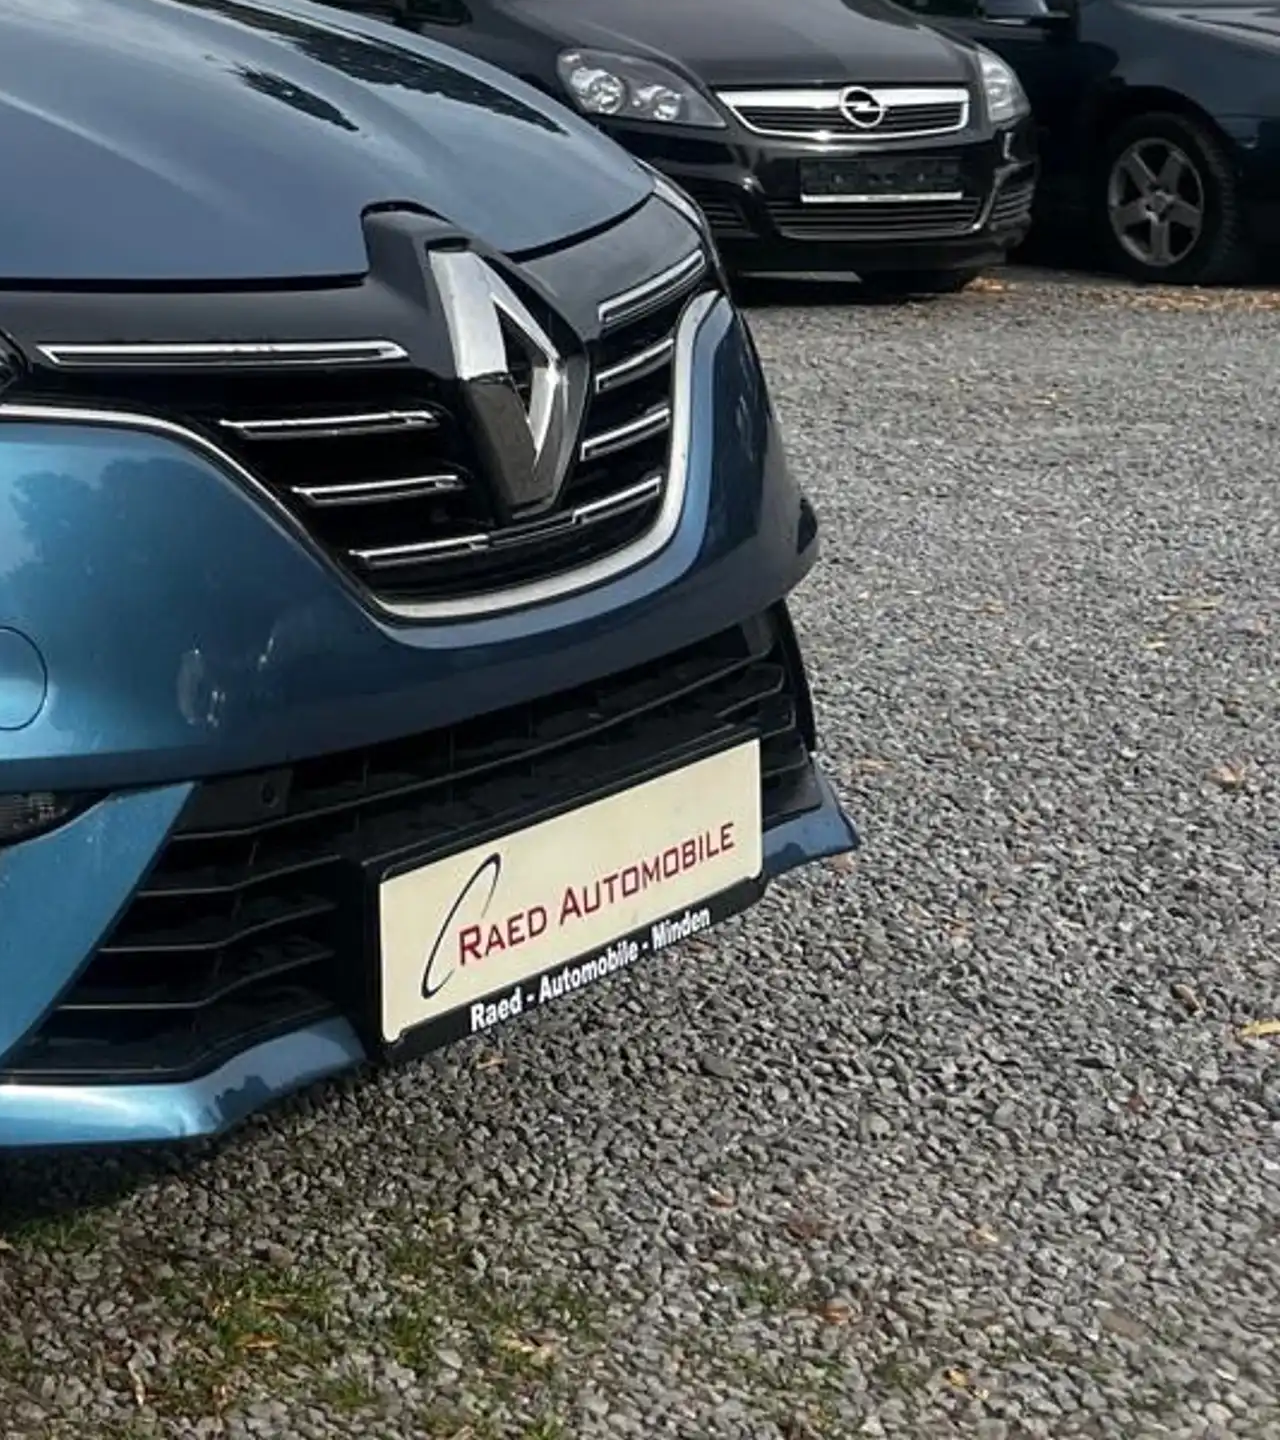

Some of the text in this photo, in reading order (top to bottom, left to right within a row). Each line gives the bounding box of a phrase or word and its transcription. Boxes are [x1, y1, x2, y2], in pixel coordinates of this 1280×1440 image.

[458, 822, 735, 967] RAED AUTOMOBILE
[470, 985, 522, 1032] Raed
[539, 939, 639, 1004] Automobile
[651, 908, 711, 951] Minden
